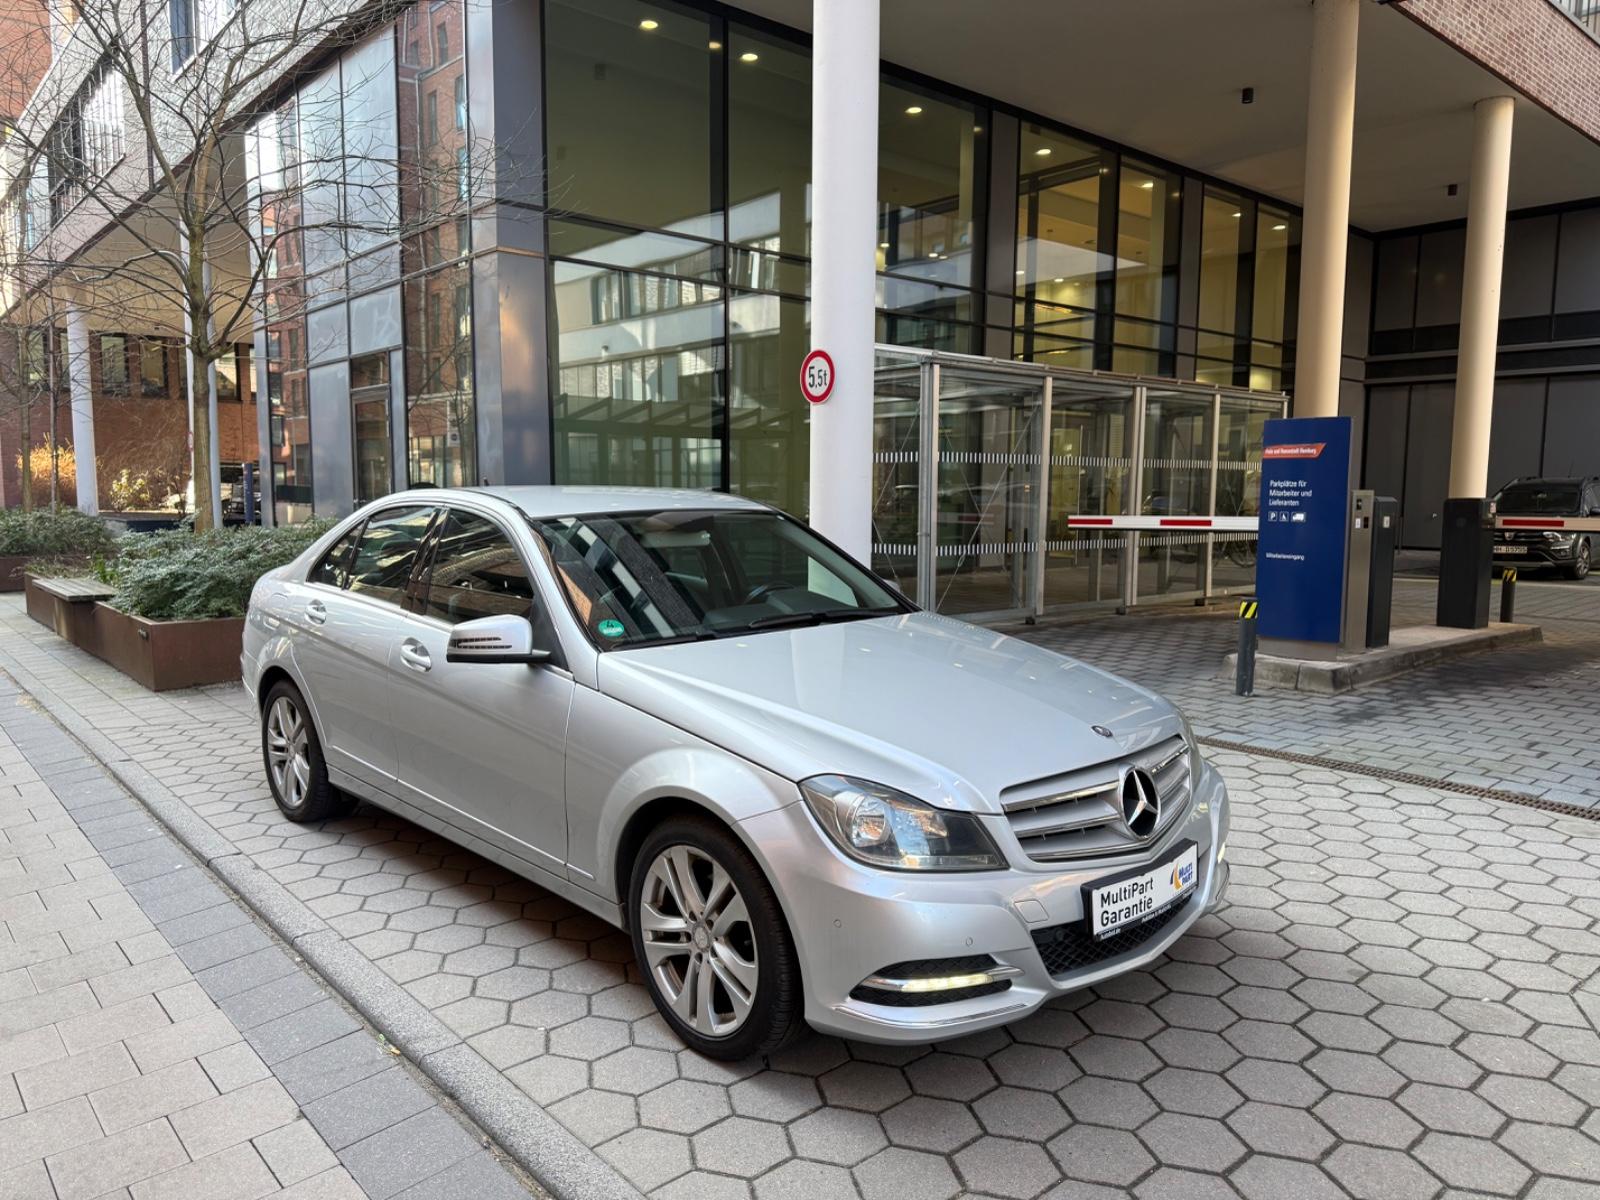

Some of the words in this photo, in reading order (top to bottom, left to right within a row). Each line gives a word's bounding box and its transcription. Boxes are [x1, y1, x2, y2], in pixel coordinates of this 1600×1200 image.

[809, 366, 827, 388] 5,5t
[1269, 479, 1297, 488] Parkplätze
[1298, 479, 1307, 487] für
[1269, 489, 1300, 497] Mitarbeiter
[1300, 489, 1313, 497] und
[1269, 498, 1300, 506] Lieferanten
[1100, 877, 1154, 908] MultiPart
[1100, 897, 1153, 928] Garantie
